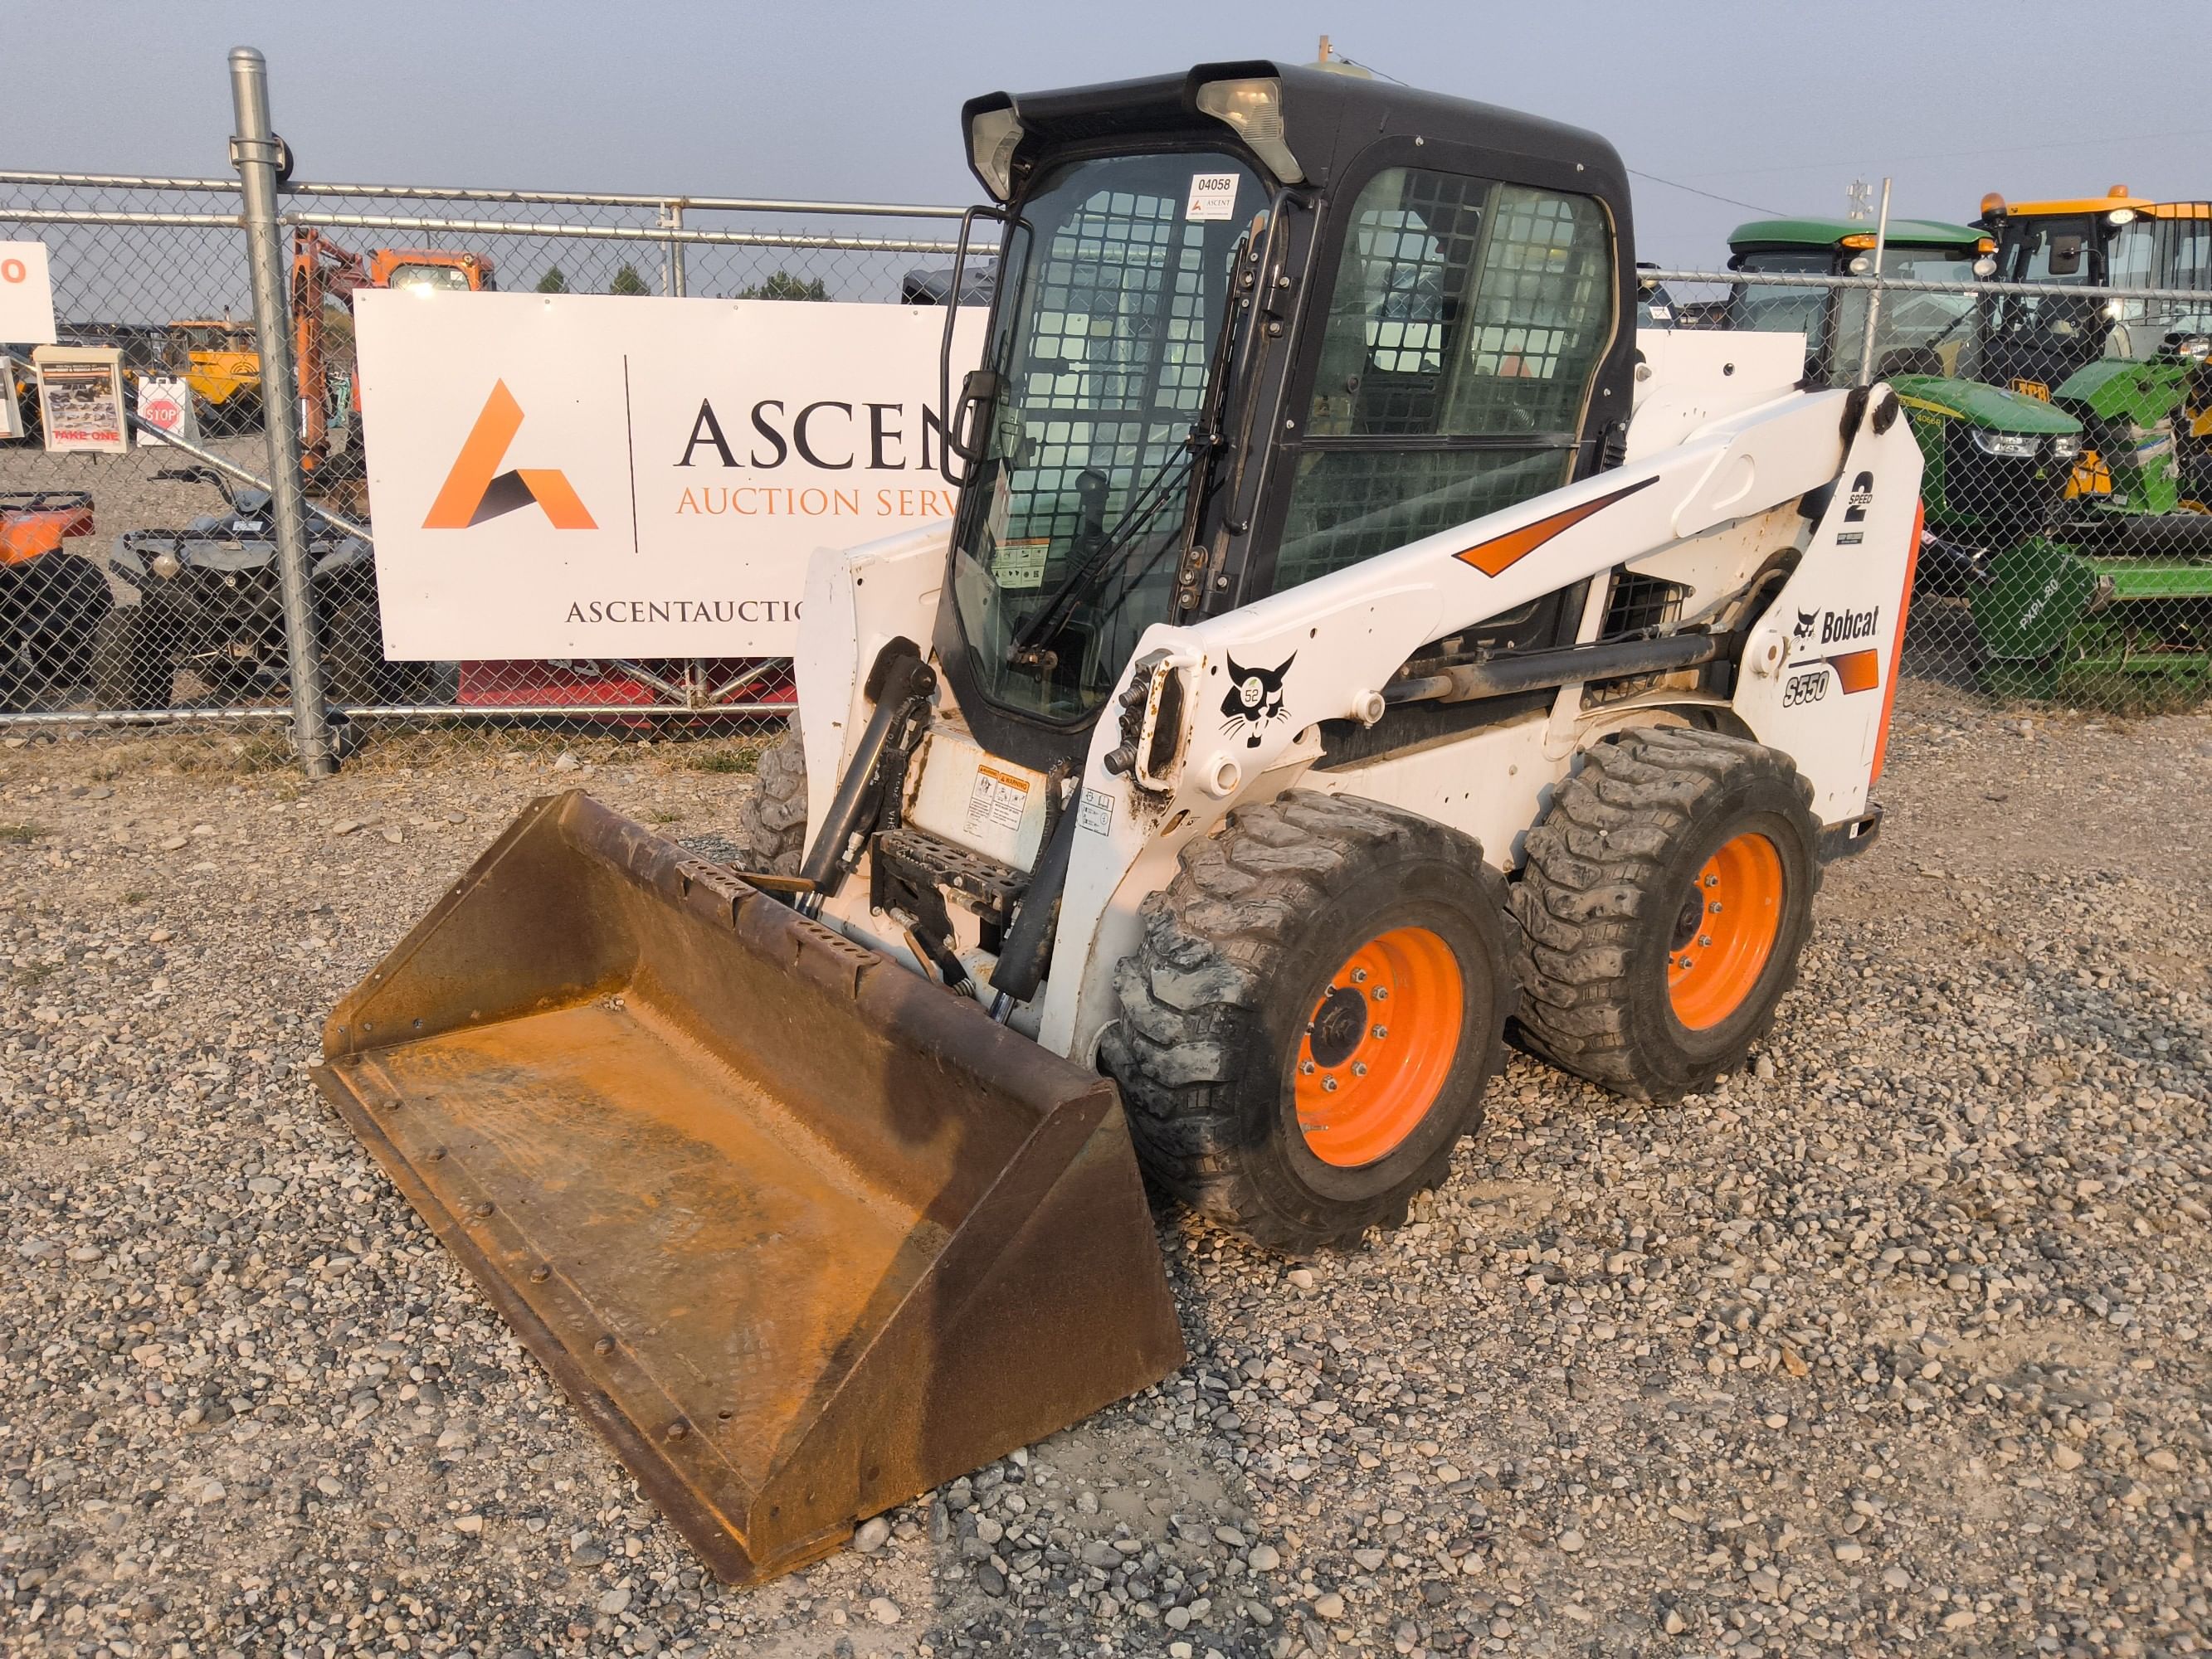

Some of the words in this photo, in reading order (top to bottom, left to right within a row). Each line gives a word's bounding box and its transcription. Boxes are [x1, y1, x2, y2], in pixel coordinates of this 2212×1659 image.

[1198, 178, 1230, 191] 04058
[146, 409, 177, 421] STOP
[52, 431, 86, 440] TAKE
[91, 431, 120, 441] ONE
[675, 486, 860, 518] AUCTION
[1849, 494, 1873, 504] SPEED
[1821, 606, 1879, 645] Bobcat
[1245, 688, 1259, 703] 52
[1782, 669, 1830, 708] S550
[1006, 777, 1027, 791] WARNING
